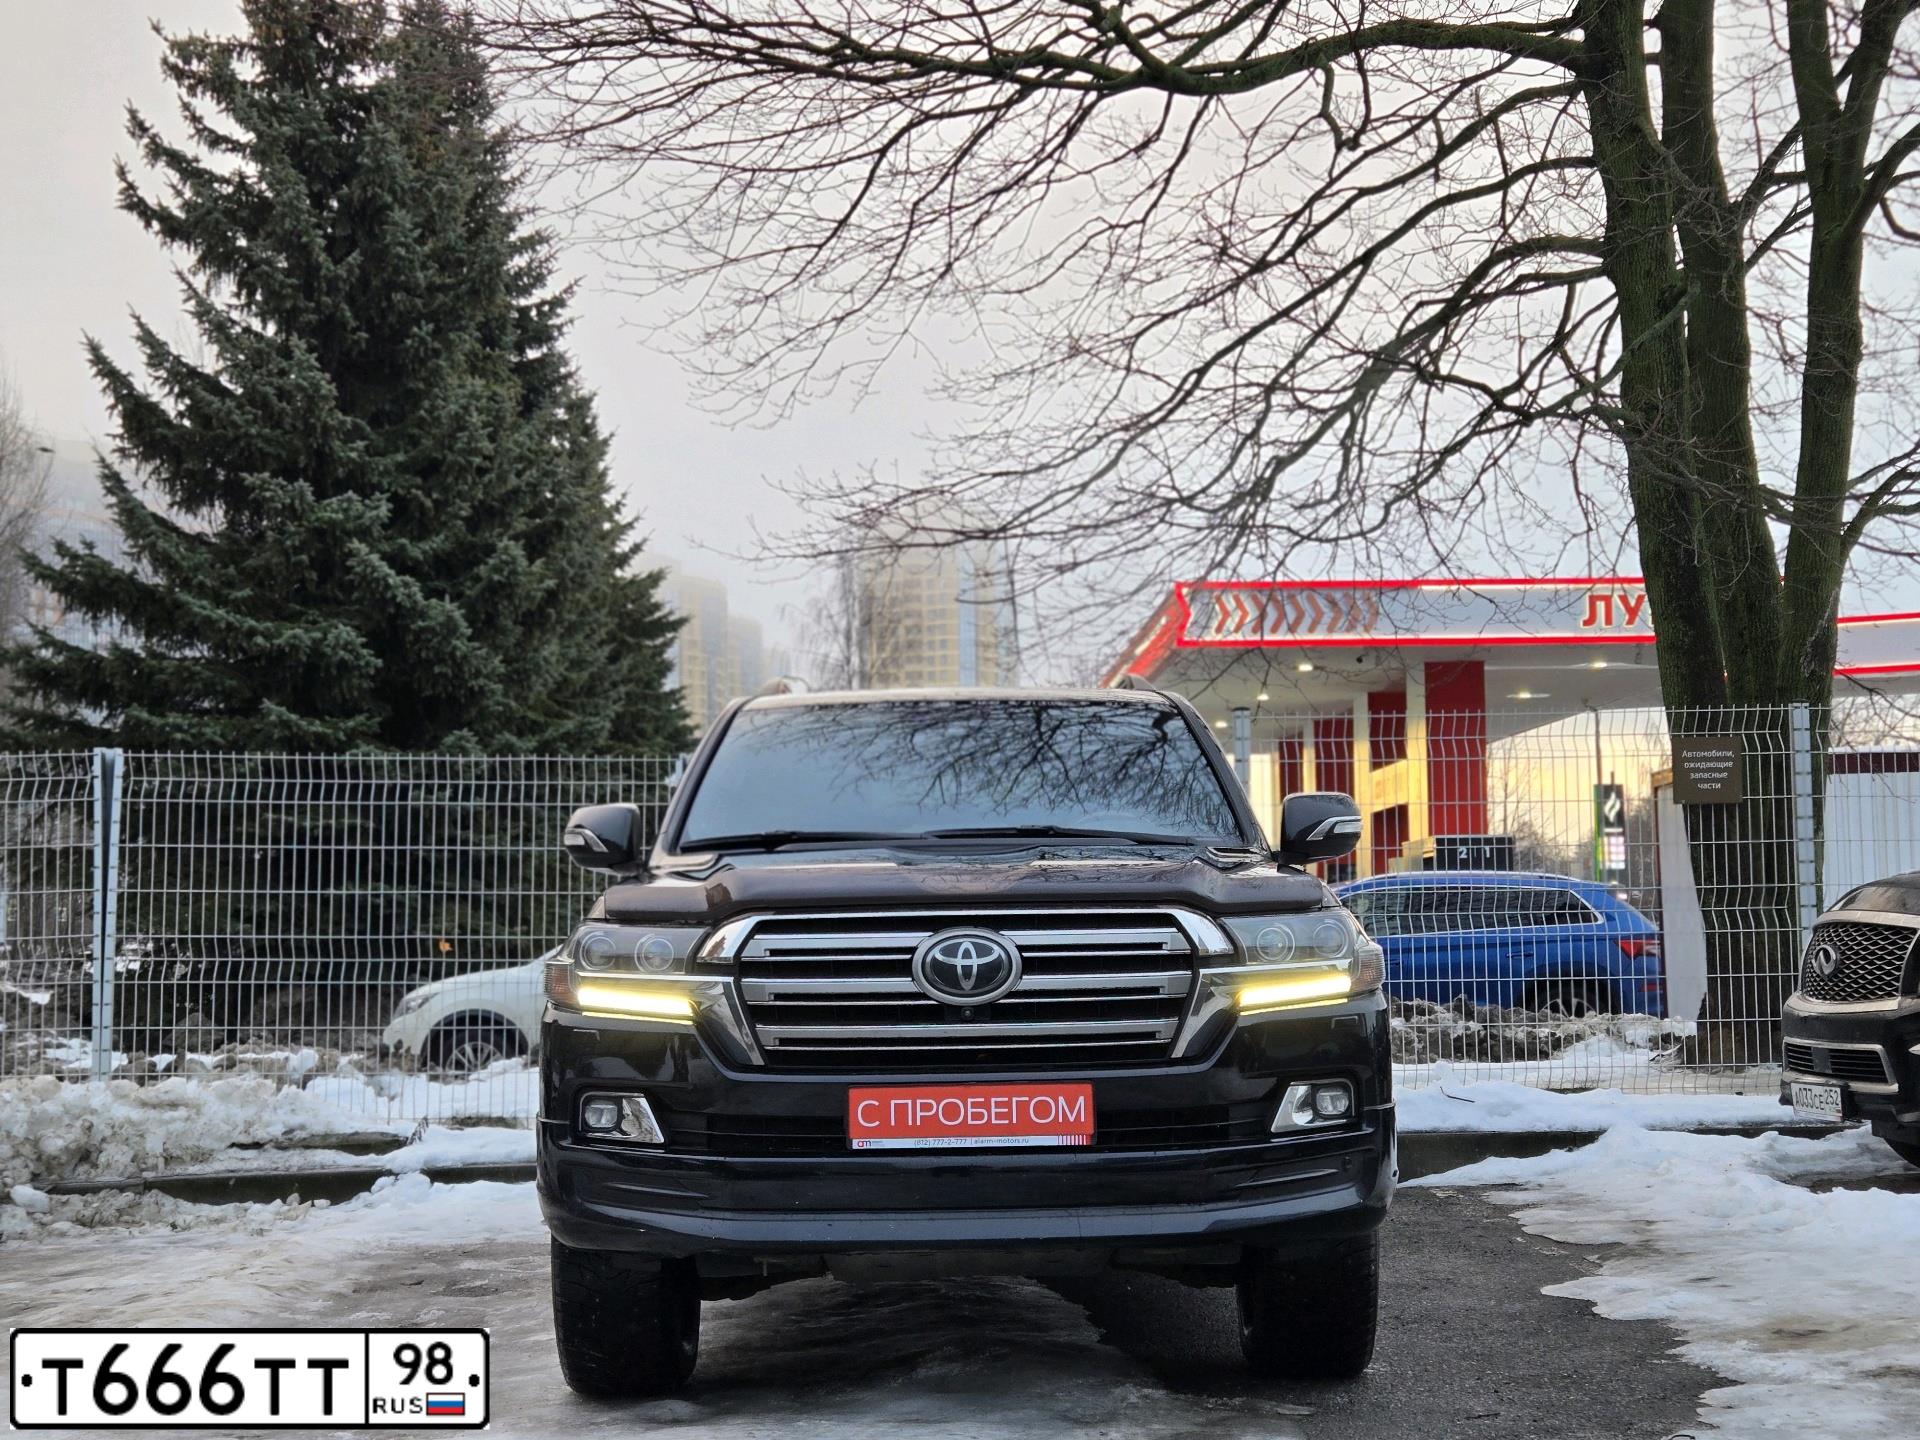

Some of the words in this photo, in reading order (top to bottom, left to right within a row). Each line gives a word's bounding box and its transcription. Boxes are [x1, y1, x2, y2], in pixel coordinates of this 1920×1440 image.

[1581, 593, 1655, 627] ЛУ
[1682, 750, 1735, 758] Автомобили,
[1684, 761, 1734, 769] ожидающие
[1459, 847, 1468, 858] 2
[857, 1100, 881, 1128] С
[890, 1096, 1085, 1126] ПРОБЕГОМ
[932, 1138, 968, 1146] 777-2-777
[973, 1137, 1030, 1145] alarm-motors.ru
